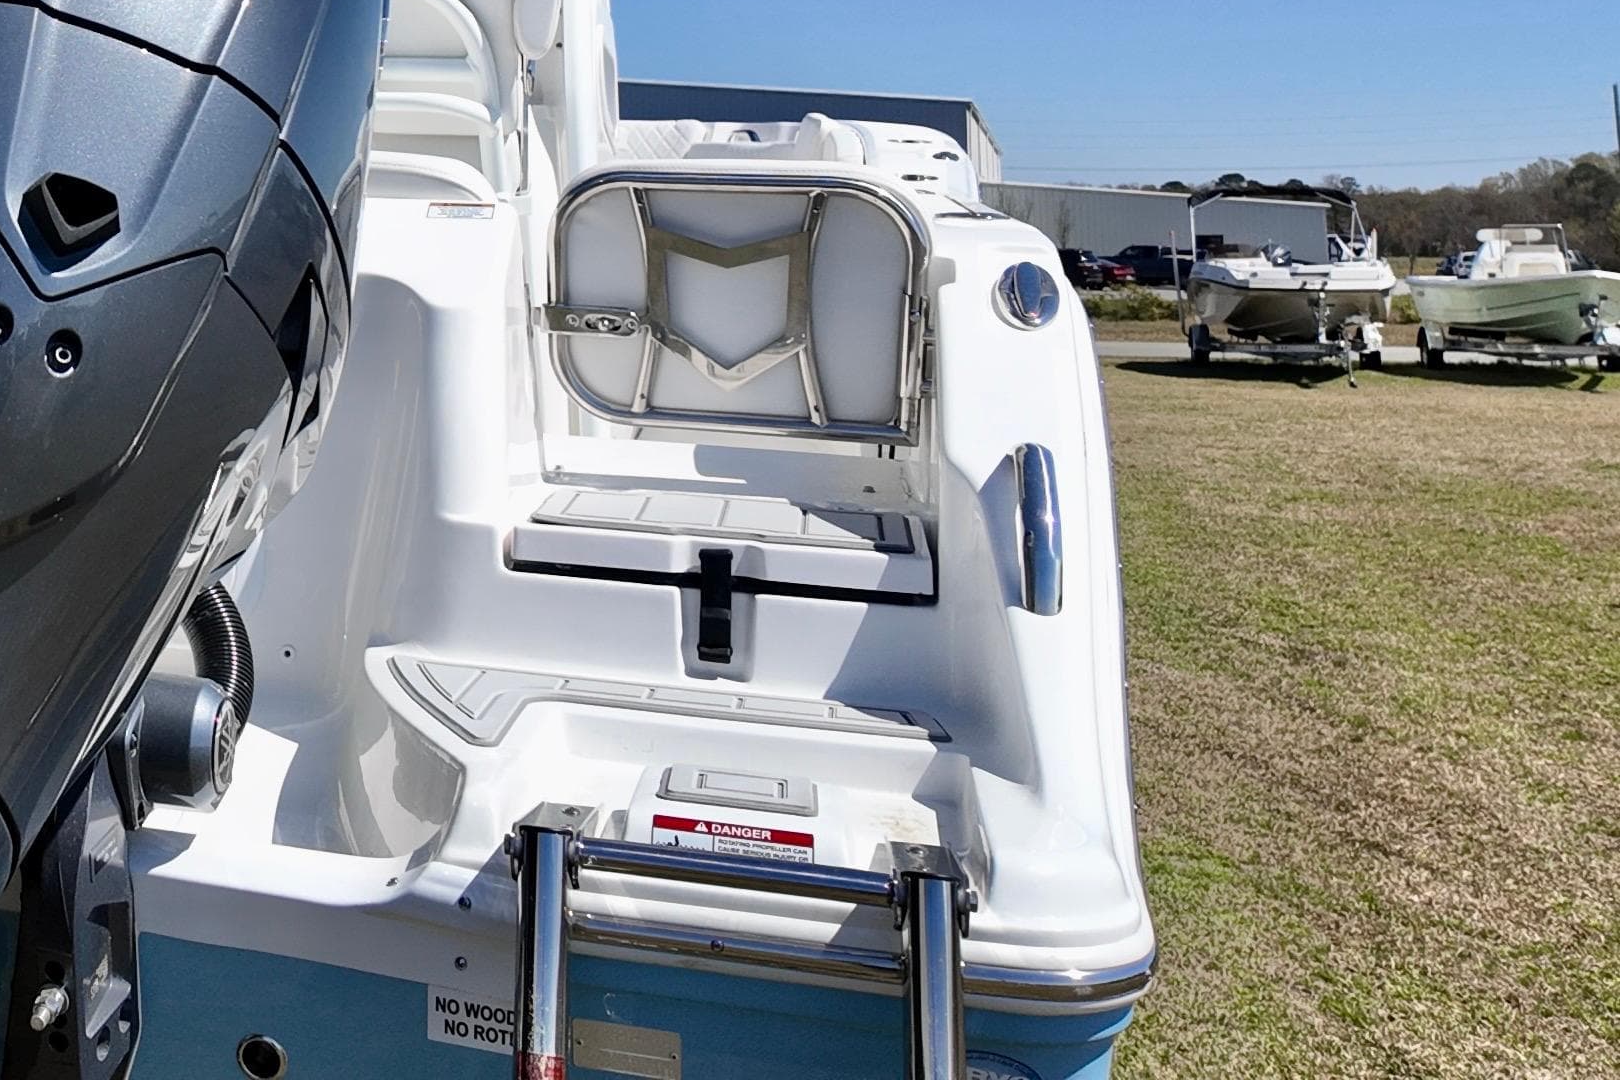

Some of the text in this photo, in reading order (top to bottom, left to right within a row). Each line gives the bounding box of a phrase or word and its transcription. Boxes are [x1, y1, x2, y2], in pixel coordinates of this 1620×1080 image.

[711, 824, 772, 840] DANGER
[718, 839, 751, 848] ROTATING
[752, 843, 792, 853] PROPELLER
[718, 846, 740, 854] CAUSE
[742, 849, 771, 858] SERIOUS
[435, 995, 515, 1025] NO WOOD
[444, 1018, 469, 1038] NO
